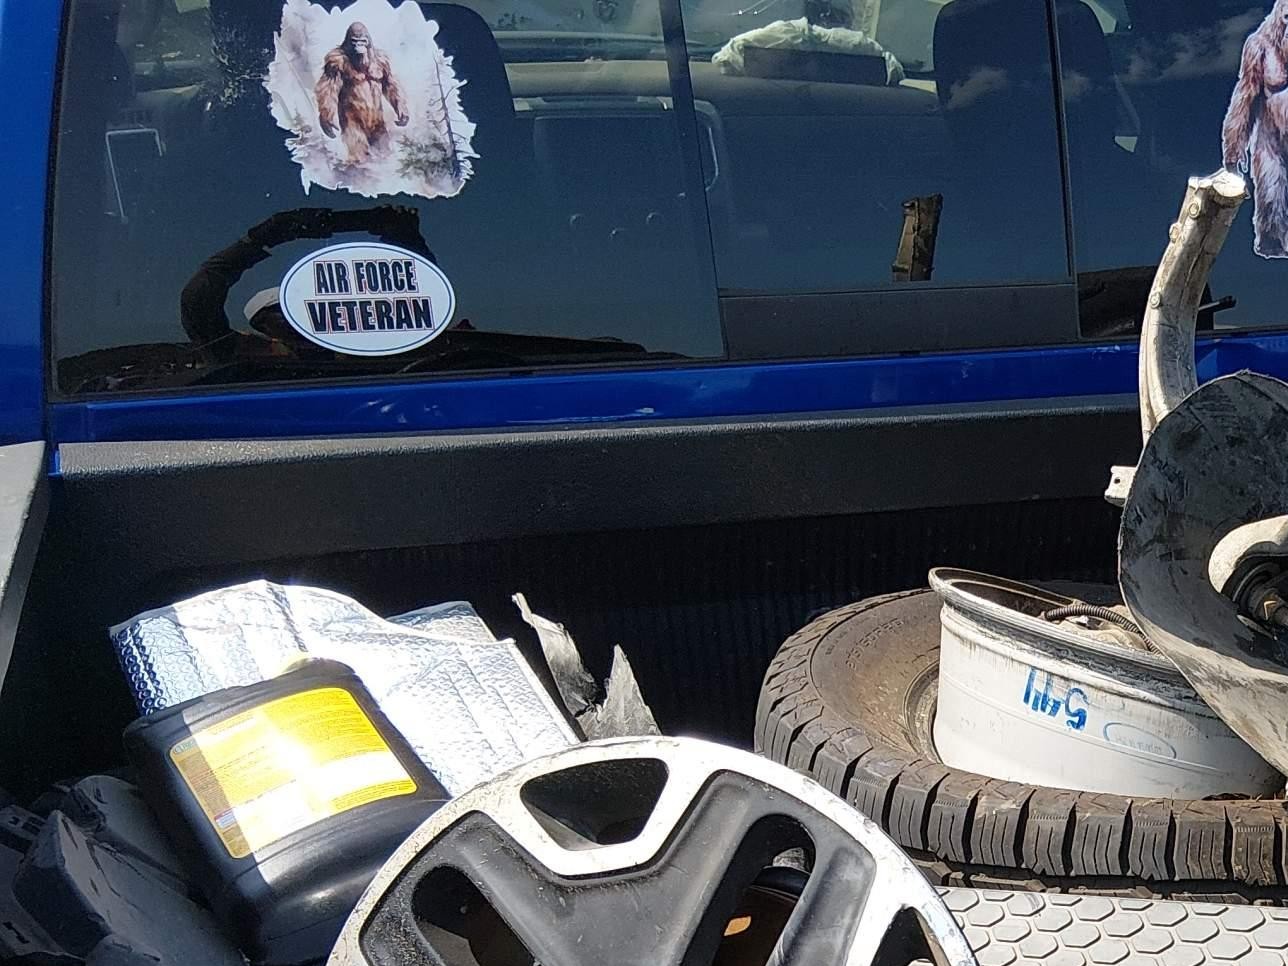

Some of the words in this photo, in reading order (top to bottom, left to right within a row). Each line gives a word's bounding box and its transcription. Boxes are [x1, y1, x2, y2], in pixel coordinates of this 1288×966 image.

[313, 260, 352, 295] AIR
[352, 259, 419, 295] FORCE
[304, 297, 435, 334] VETERAN
